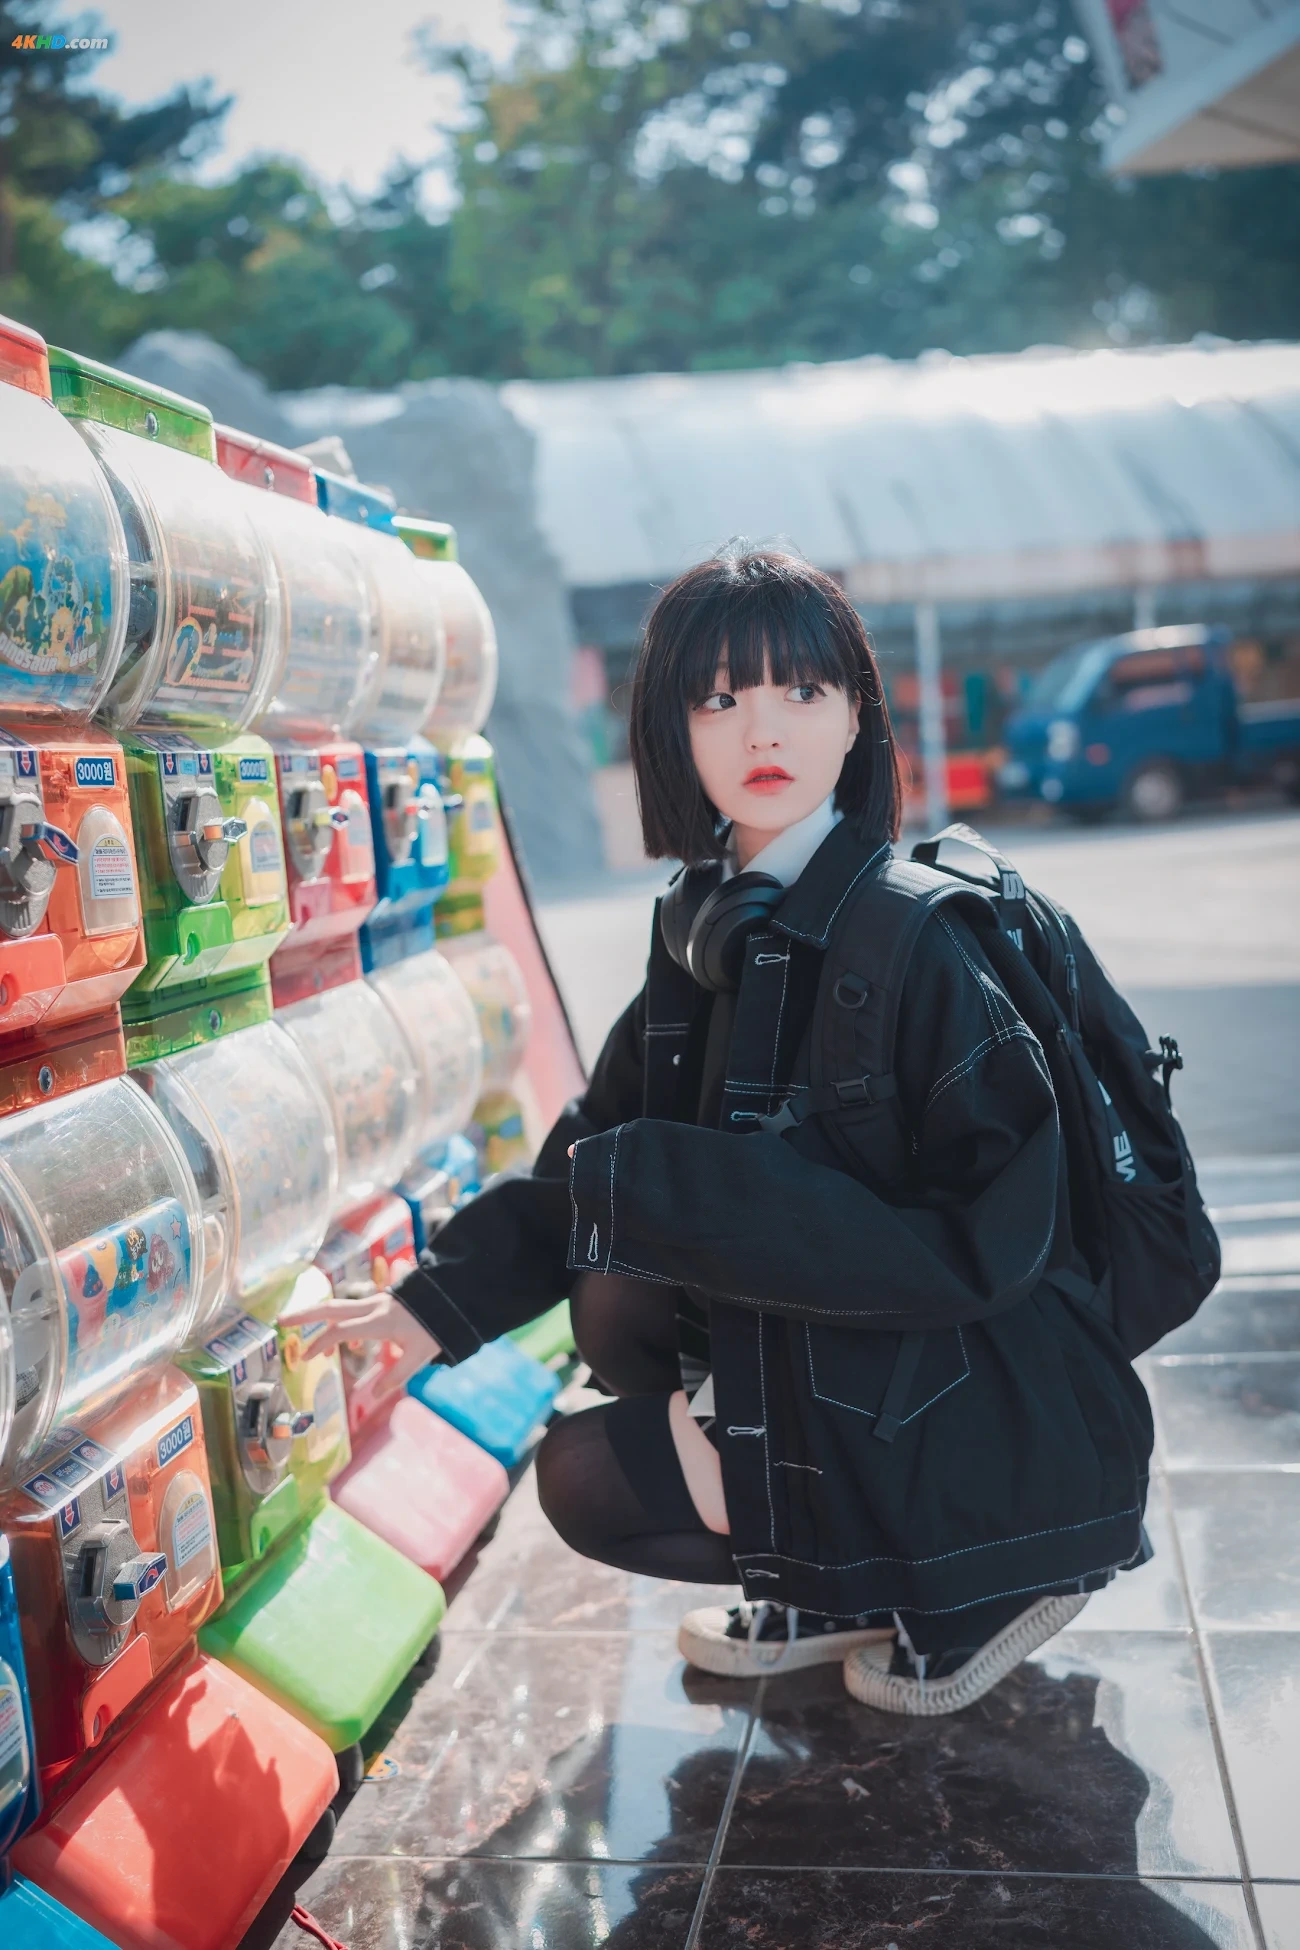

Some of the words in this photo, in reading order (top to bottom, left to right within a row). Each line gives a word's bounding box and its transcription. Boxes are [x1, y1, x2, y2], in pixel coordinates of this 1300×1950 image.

[77, 761, 113, 781] 3000원
[240, 760, 267, 777] 3000원
[160, 1419, 192, 1460] 3000원
